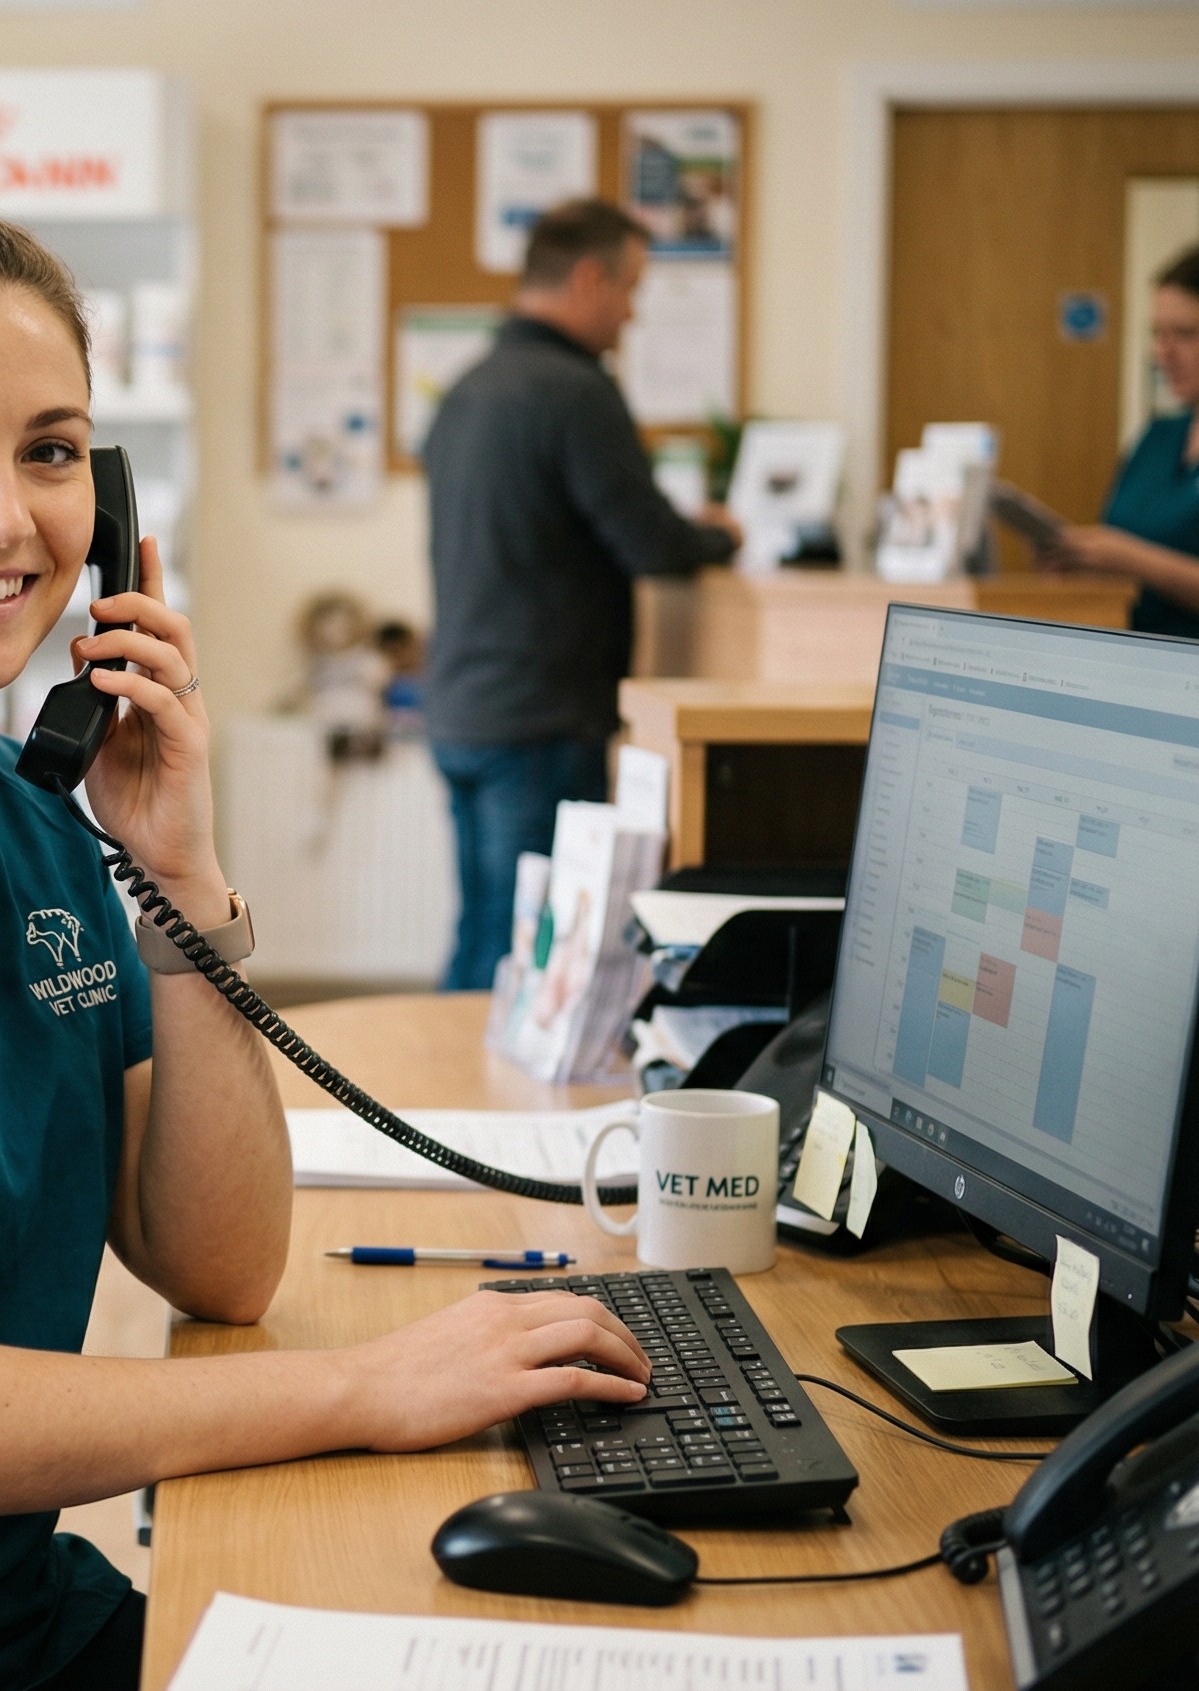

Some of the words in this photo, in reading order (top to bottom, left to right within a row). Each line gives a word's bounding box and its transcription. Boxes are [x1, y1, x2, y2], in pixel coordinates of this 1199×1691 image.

[29, 960, 117, 1001] WILDWOOD
[49, 995, 75, 1016] VET
[77, 984, 117, 1009] CLINIC
[656, 1169, 699, 1195] VET
[705, 1175, 760, 1197] MED
